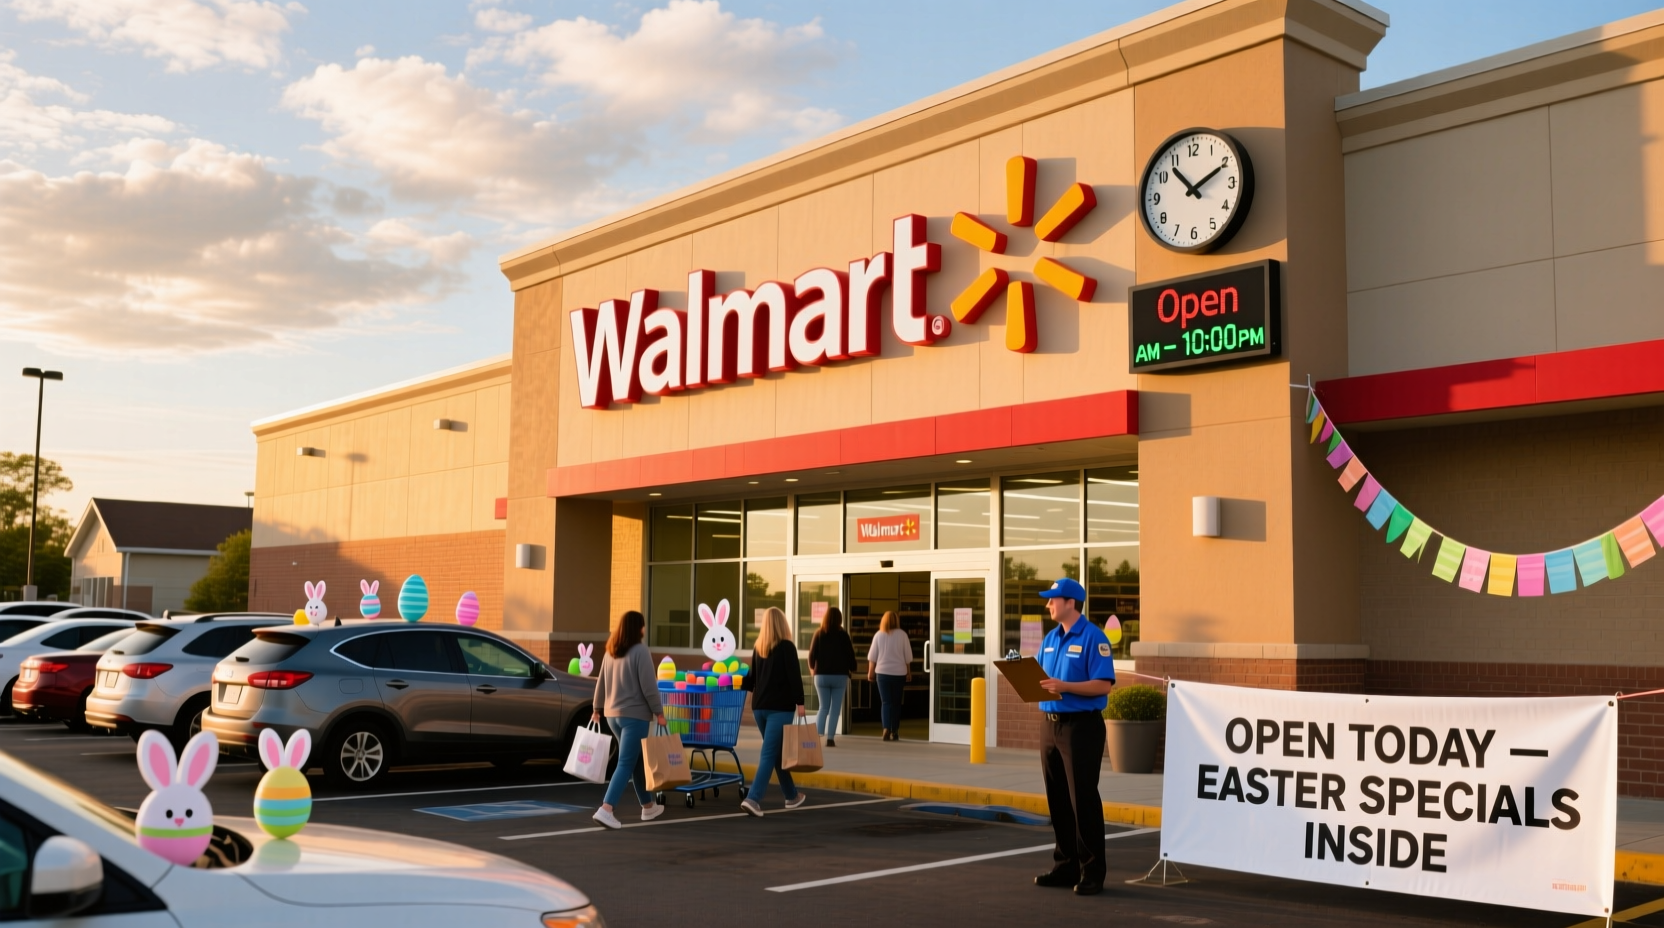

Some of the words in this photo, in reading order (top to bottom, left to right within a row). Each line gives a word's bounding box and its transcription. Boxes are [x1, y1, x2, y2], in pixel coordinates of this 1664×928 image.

[1188, 143, 1199, 158] 12
[1209, 144, 1214, 157] 1
[1170, 154, 1180, 167] 11
[1221, 156, 1230, 169] 2
[1228, 176, 1237, 189] 3
[1153, 192, 1161, 205] 9
[1221, 199, 1230, 212] 4
[1159, 212, 1168, 225] 8
[1209, 217, 1217, 230] 5
[1173, 224, 1181, 237] 7
[1190, 226, 1198, 240] 6
[570, 213, 941, 410] Walmart
[1157, 286, 1239, 328] Open
[1135, 342, 1161, 363] AM
[1225, 717, 1335, 760] OPEN
[1348, 723, 1497, 768] TODAY
[1197, 763, 1346, 812] EASTER
[1359, 775, 1582, 831] SPECIALS
[1304, 821, 1449, 873] INSIDE
